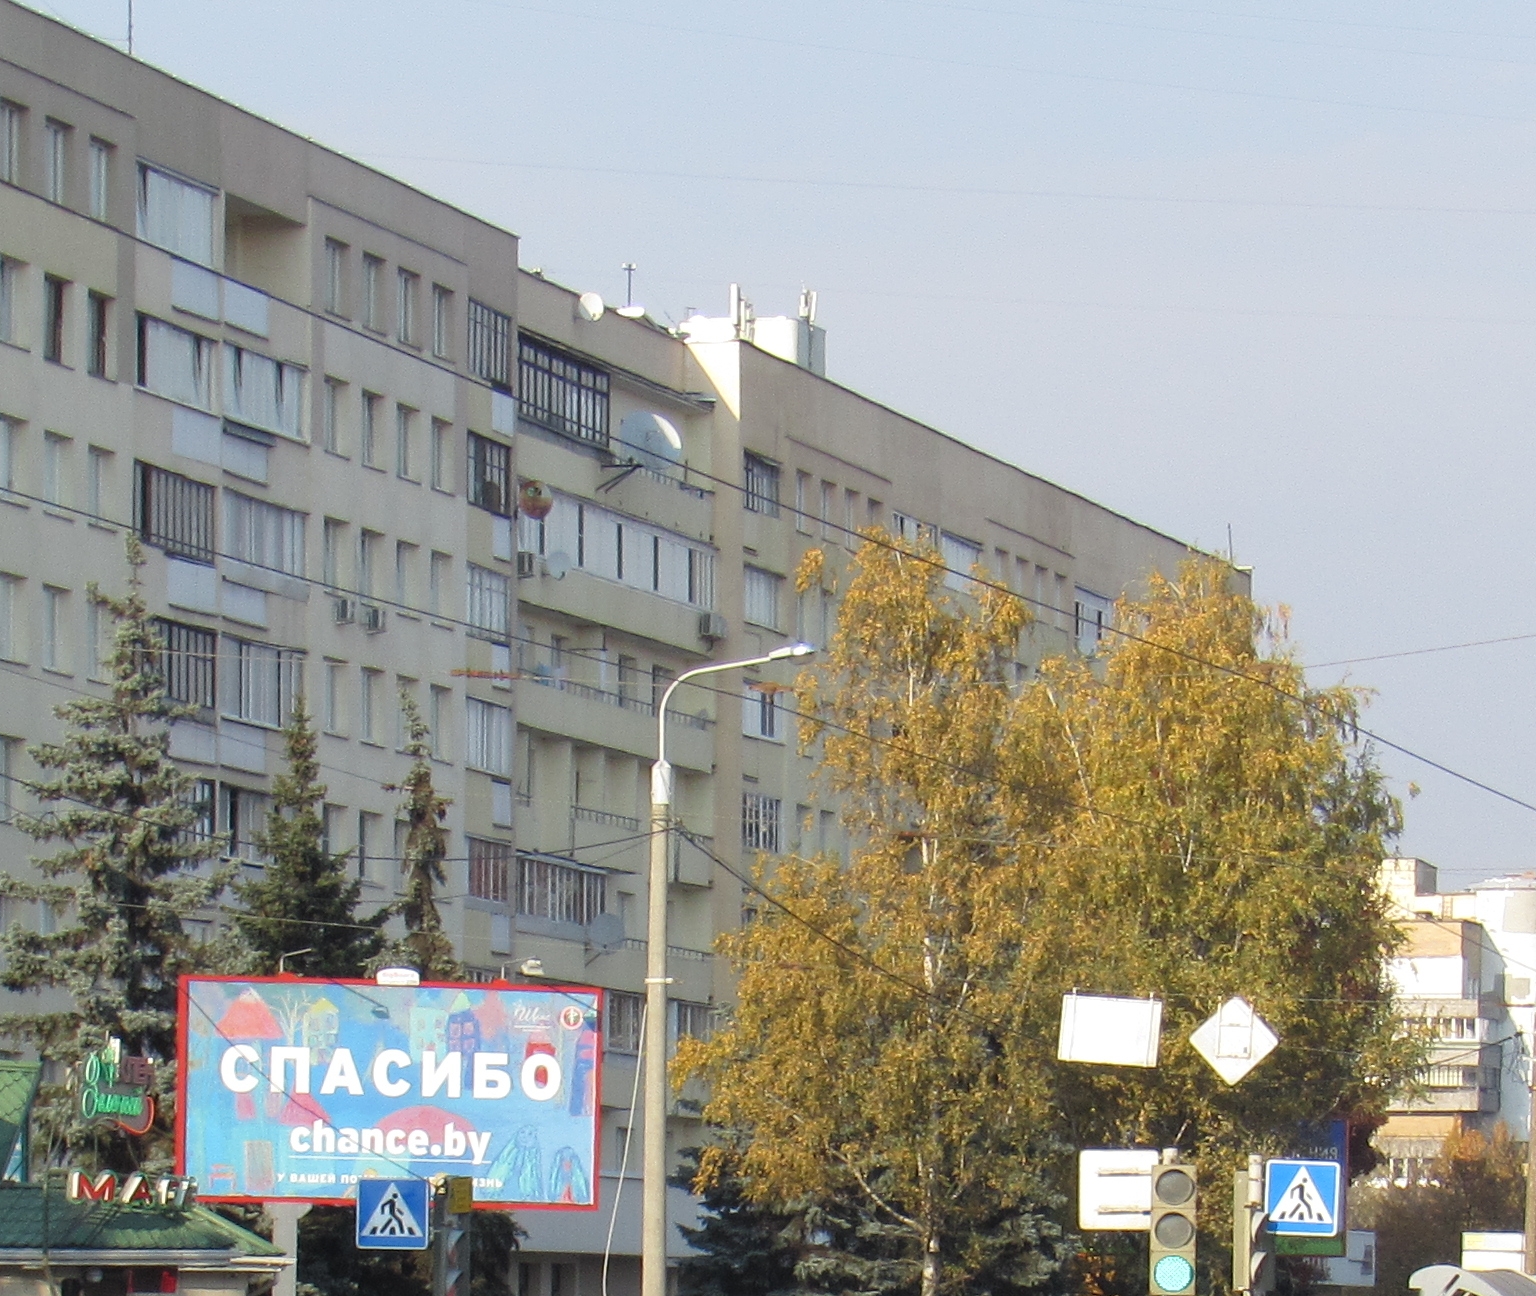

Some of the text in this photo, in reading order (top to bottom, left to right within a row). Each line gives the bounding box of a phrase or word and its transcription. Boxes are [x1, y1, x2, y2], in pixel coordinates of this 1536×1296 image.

[220, 1045, 562, 1100] СПАСИБО
[289, 1118, 492, 1165] chance.by
[277, 1172, 286, 1184] У
[289, 1172, 336, 1185] ВАШЕЙ
